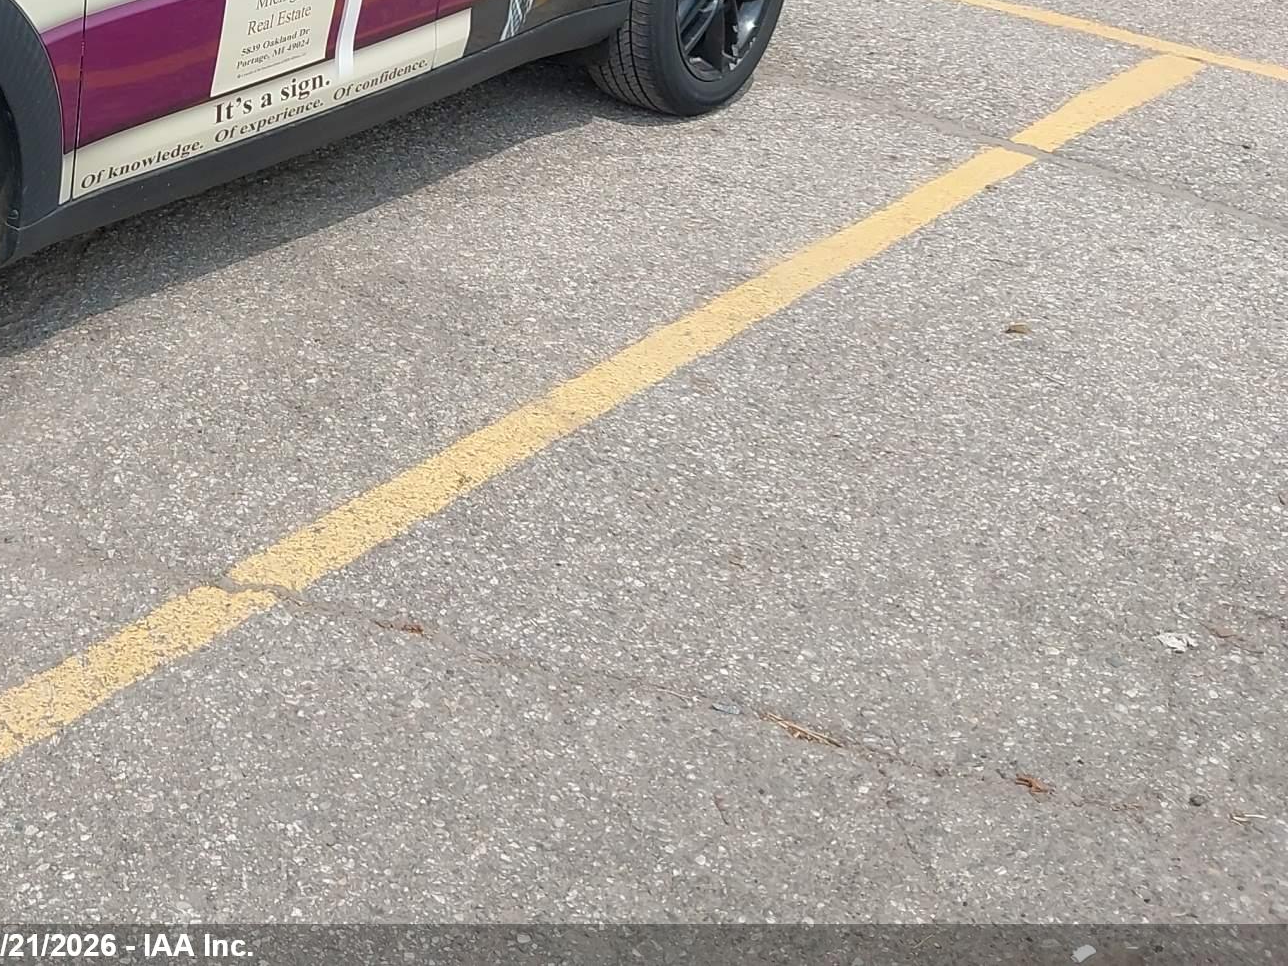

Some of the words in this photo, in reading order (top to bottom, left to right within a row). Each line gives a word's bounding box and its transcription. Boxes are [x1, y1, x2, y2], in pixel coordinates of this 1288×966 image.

[247, 13, 275, 36] Real
[277, 6, 312, 27] Estate
[263, 31, 298, 49] Oakland
[272, 46, 286, 57] MI
[214, 96, 253, 124] It's
[260, 92, 272, 109] a
[279, 74, 331, 101] sign.
[81, 169, 106, 189] Of
[107, 141, 204, 180] knowledge.
[215, 125, 238, 143] Of
[239, 98, 324, 135] experience.
[333, 87, 354, 101] Of
[355, 58, 429, 93] confidence.
